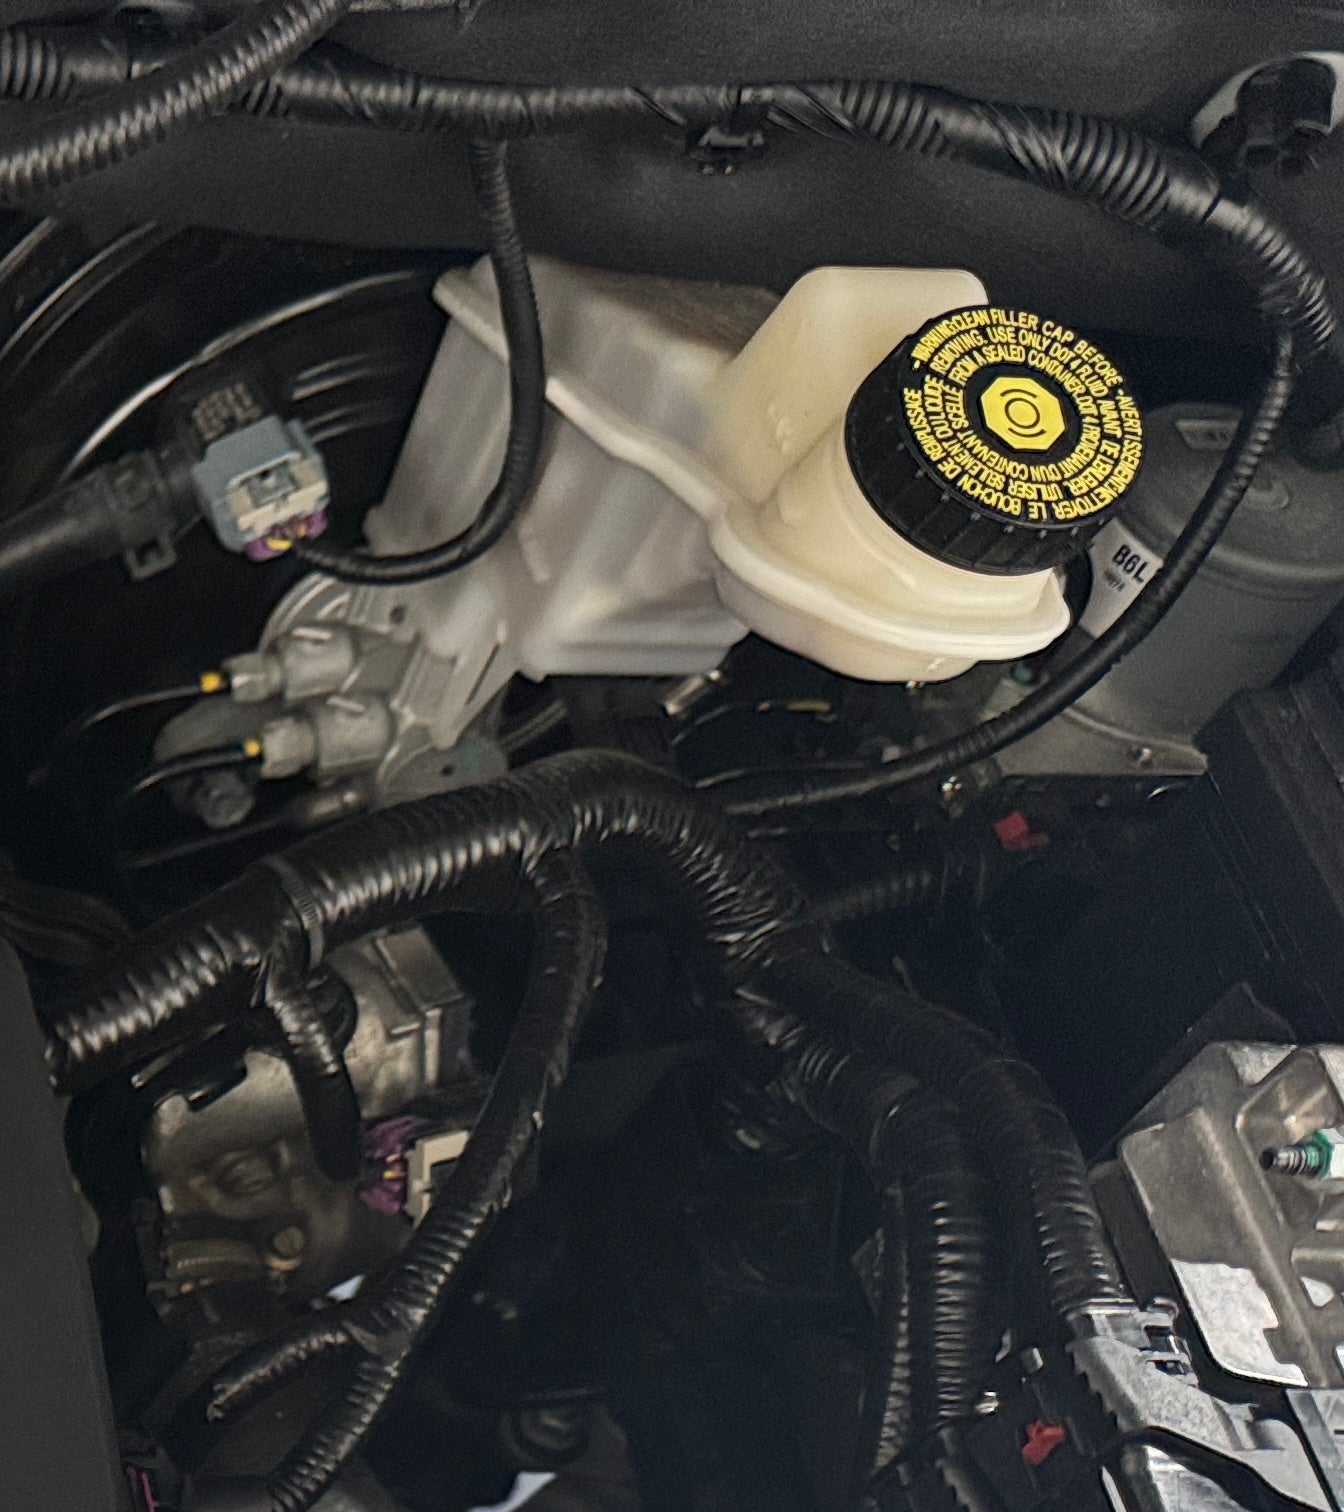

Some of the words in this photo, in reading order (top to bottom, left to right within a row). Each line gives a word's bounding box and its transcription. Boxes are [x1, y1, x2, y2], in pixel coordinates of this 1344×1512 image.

[986, 326, 1017, 343] USE
[1018, 329, 1051, 351] ONLY
[990, 309, 1039, 331] FILLER
[1042, 321, 1075, 343] CAP
[1074, 340, 1123, 387] BEFORE
[1049, 342, 1076, 364] DOT
[948, 355, 980, 386] FROM
[973, 350, 987, 367] A
[982, 344, 1025, 363] SEALED
[1028, 350, 1086, 399] CONTAINER
[1070, 358, 1082, 370] 4
[1075, 364, 1109, 397] FLUID
[1076, 396, 1098, 416] DOT
[1097, 400, 1122, 438] AVANT
[957, 429, 1028, 480] CONTENANT
[1100, 440, 1121, 459] DE
[937, 457, 961, 480] DE
[942, 439, 1006, 491] SEULEMENT
[957, 474, 1021, 516] BOUCHON
[1008, 479, 1063, 501] UTILISER
[1027, 501, 1047, 520] LE
